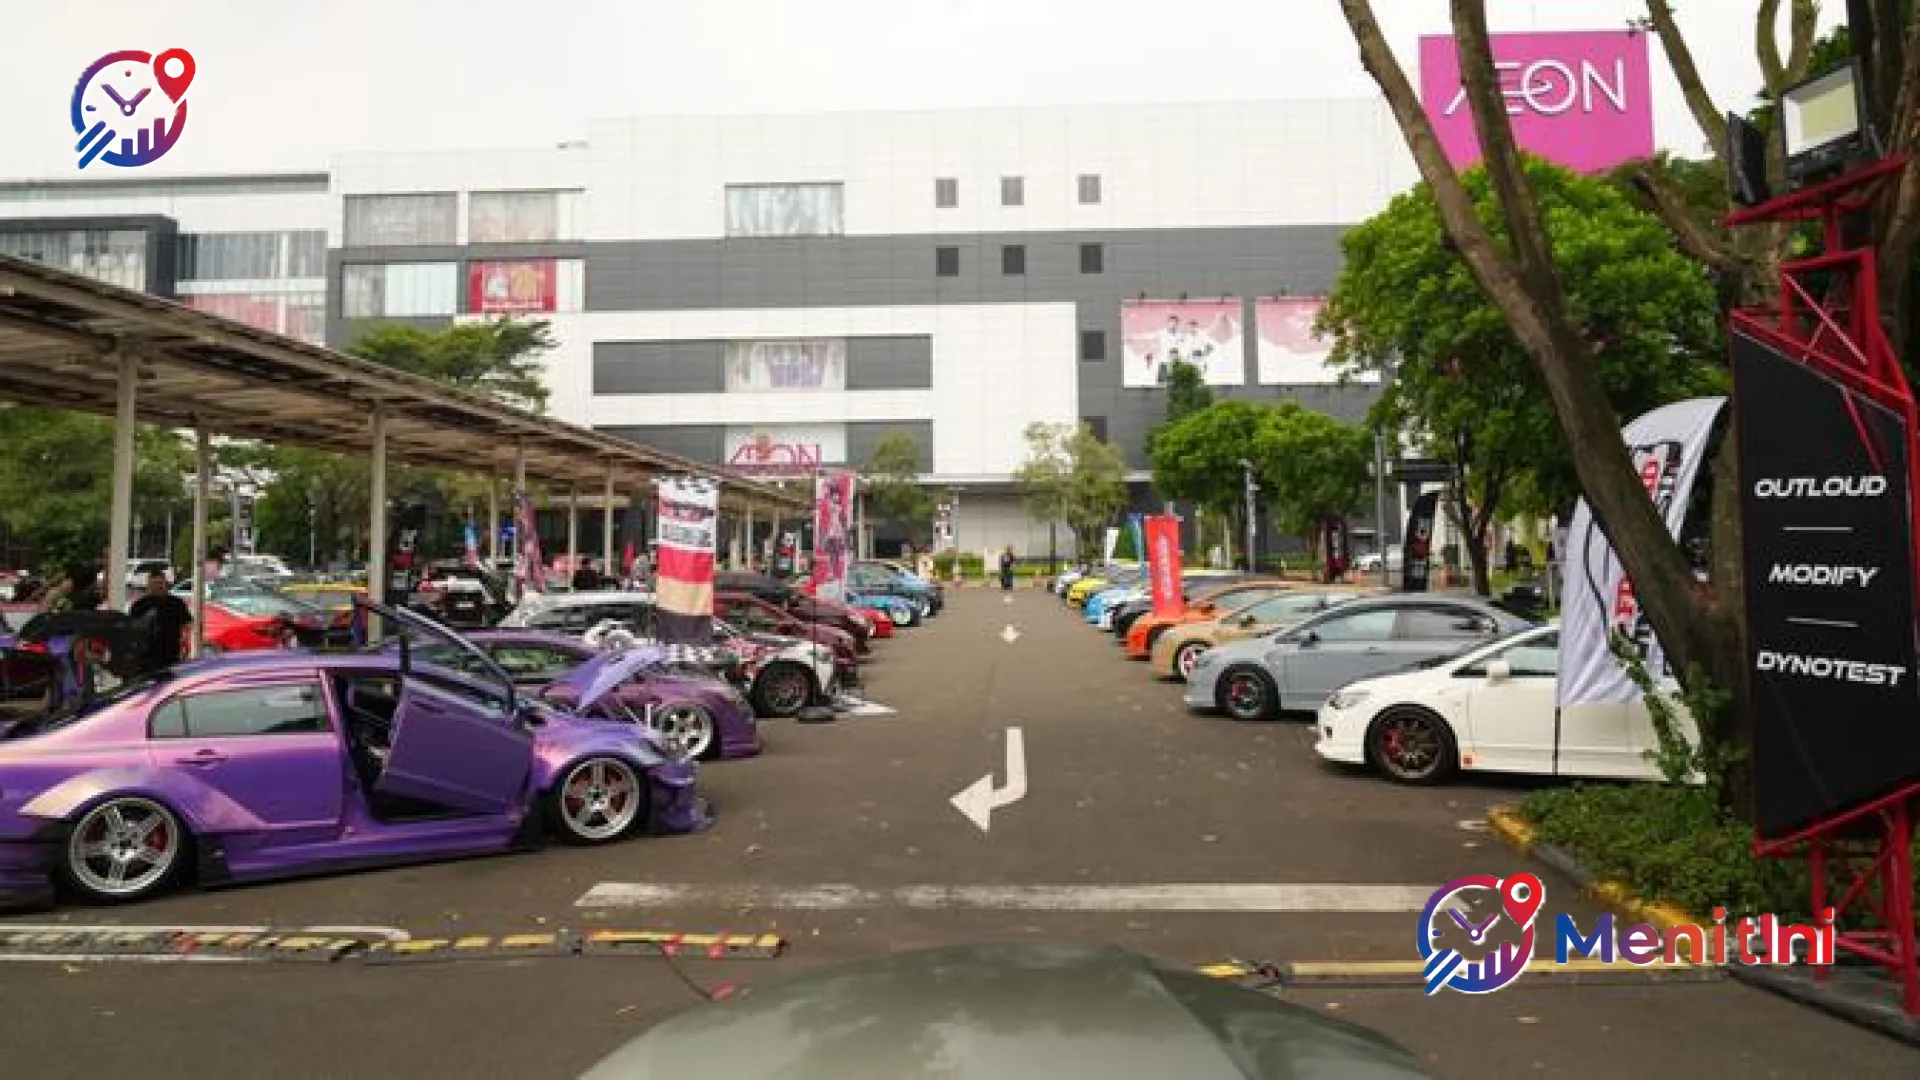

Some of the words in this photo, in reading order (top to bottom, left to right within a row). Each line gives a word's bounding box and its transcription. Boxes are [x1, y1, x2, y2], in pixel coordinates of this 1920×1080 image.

[1754, 475, 1887, 497] OUTLOUD
[1768, 563, 1880, 588] MODIFY
[1757, 650, 1906, 687] DYNOTEST
